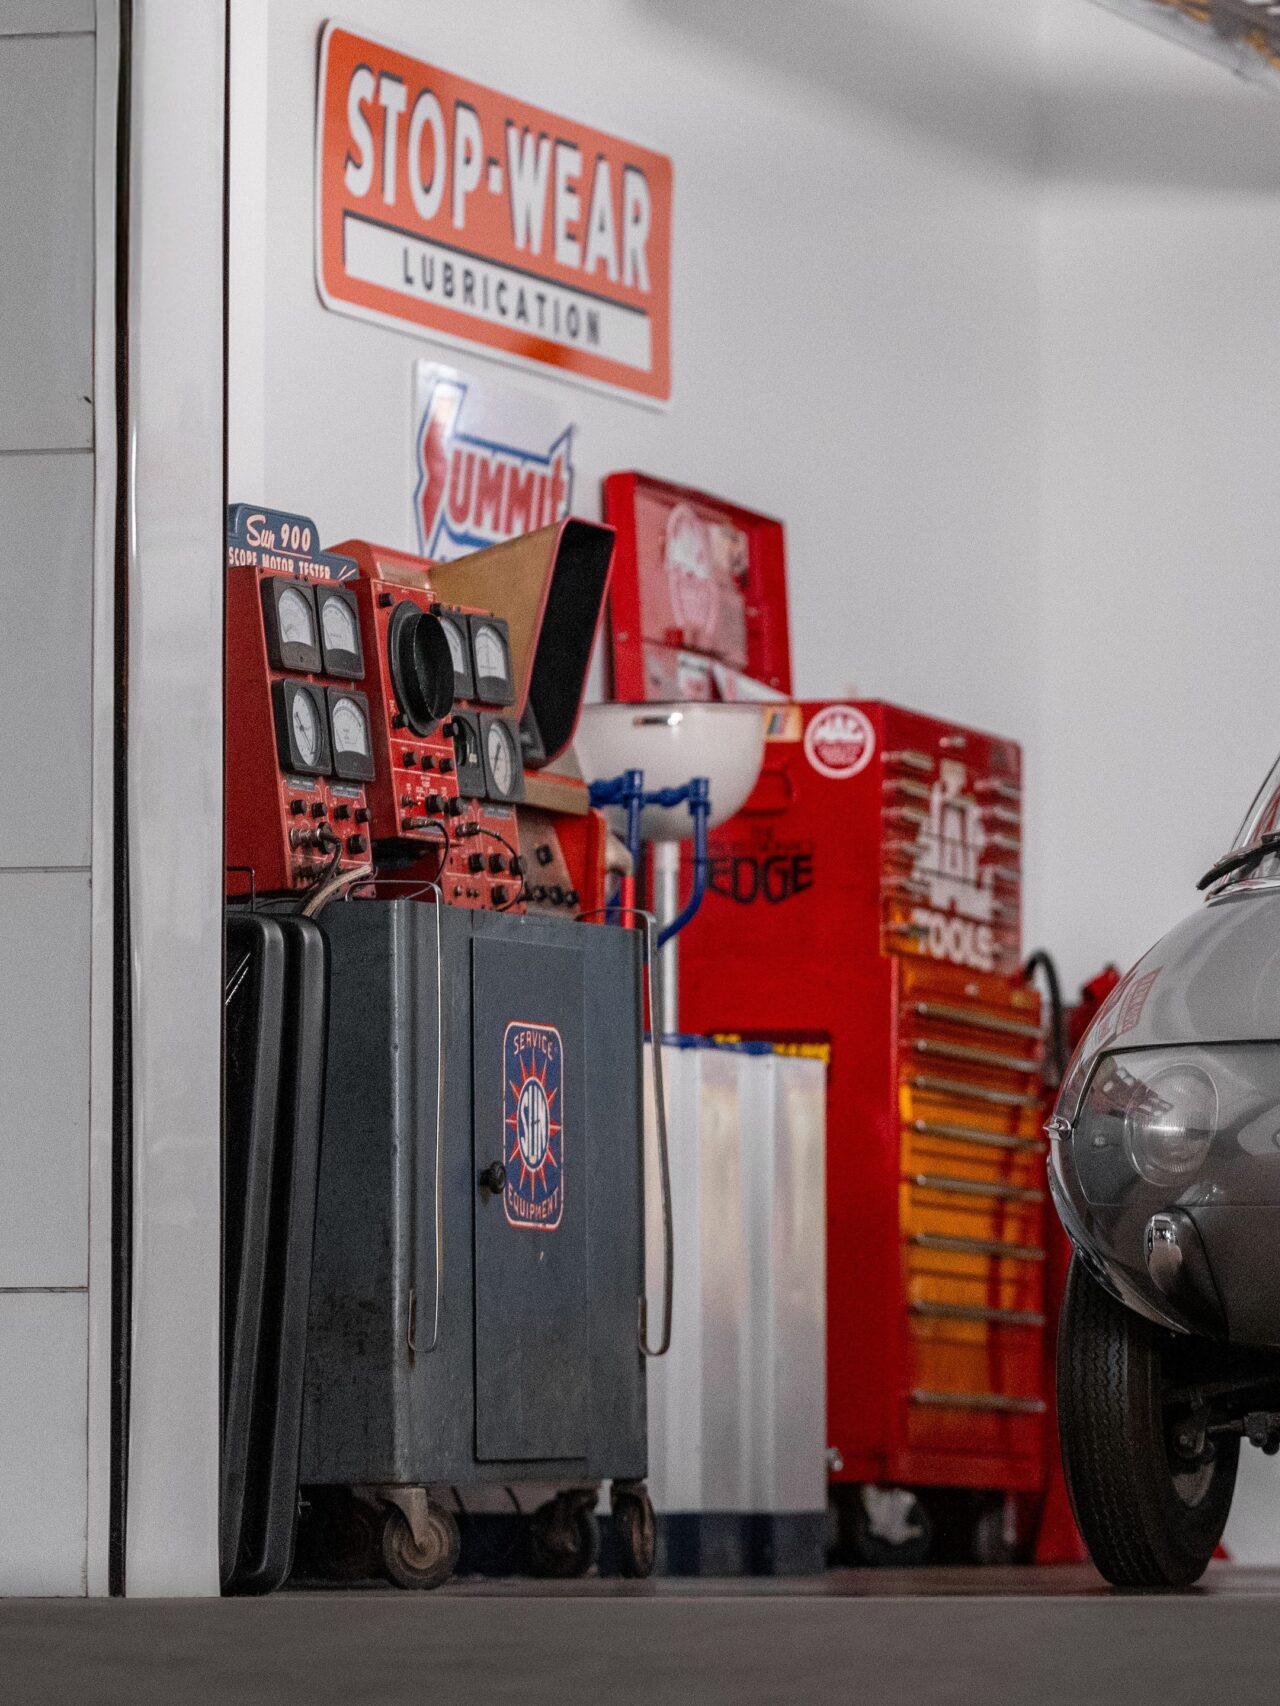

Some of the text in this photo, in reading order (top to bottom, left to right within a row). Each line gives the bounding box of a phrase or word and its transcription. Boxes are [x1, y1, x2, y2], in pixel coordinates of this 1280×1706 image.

[344, 63, 651, 293] STOP-WEAR
[402, 246, 600, 345] LUBRICATION
[246, 513, 311, 552] Sun 900
[228, 546, 331, 579] SCOPE MOTOR TESTER
[513, 1030, 554, 1061] SERVICE
[519, 1084, 548, 1166] SUN
[508, 1182, 560, 1221] EQUIPMENT
